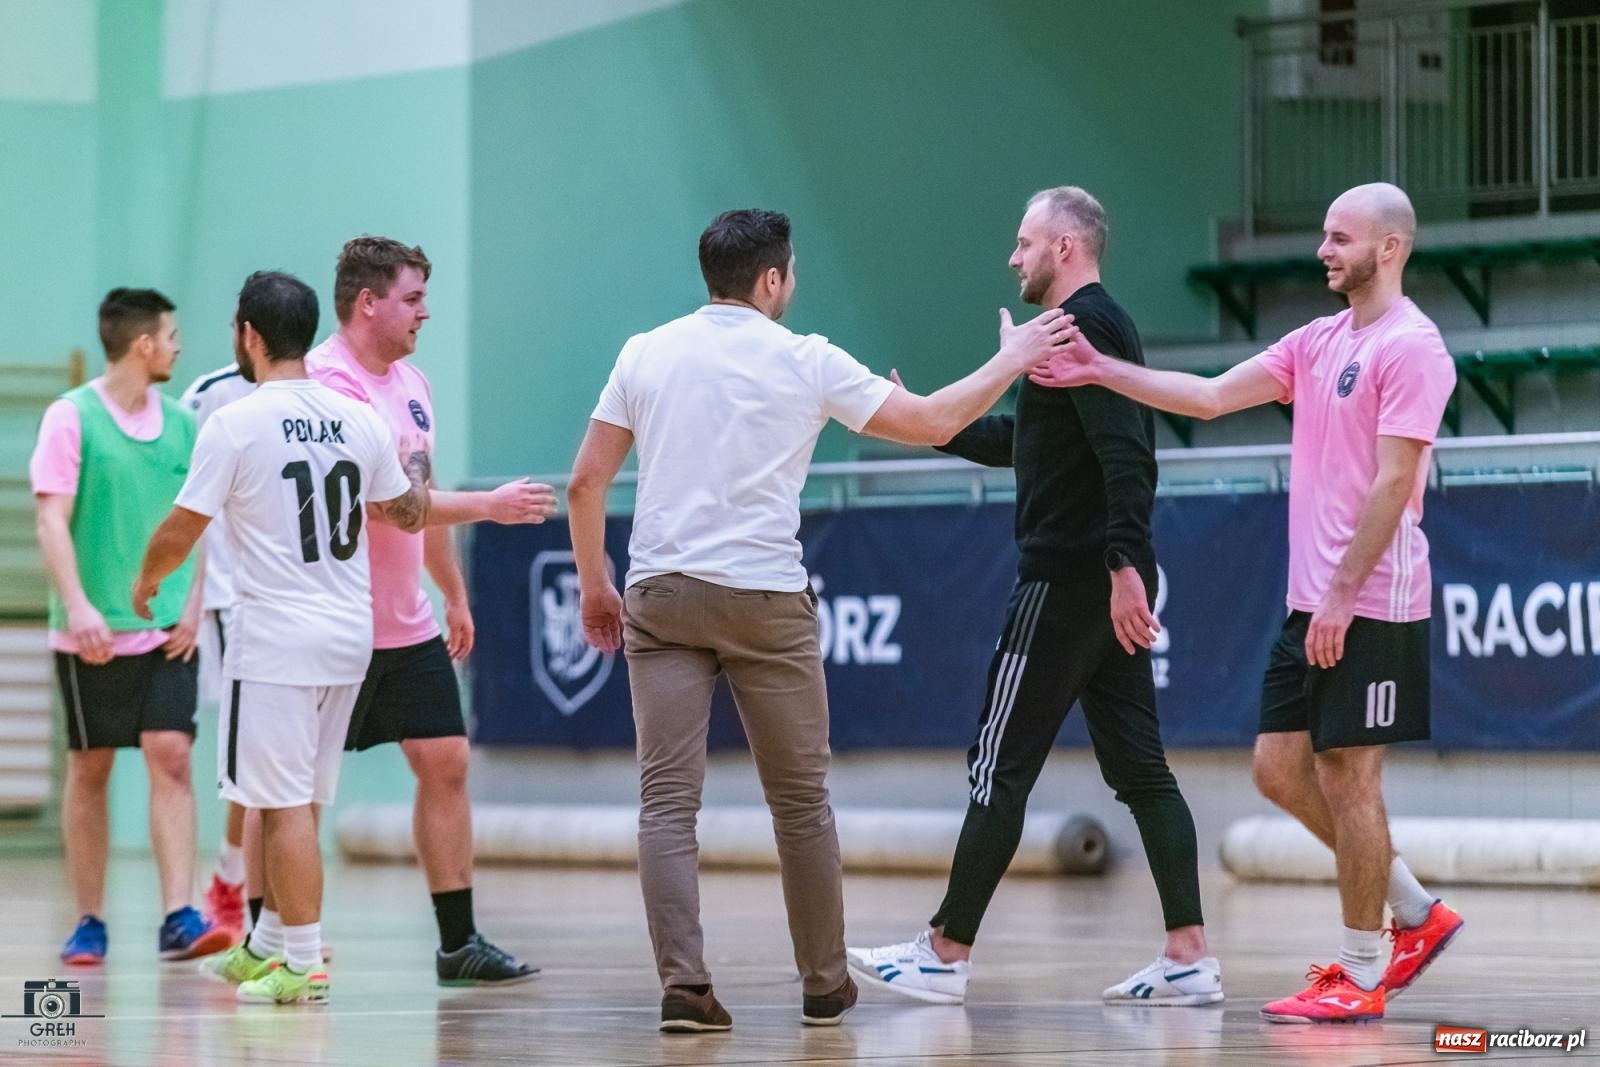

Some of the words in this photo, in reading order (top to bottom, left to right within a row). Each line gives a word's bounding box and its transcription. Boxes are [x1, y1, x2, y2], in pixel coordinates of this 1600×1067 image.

[282, 419, 345, 444] POLAK
[281, 460, 362, 563] 10
[1365, 680, 1396, 728] 10
